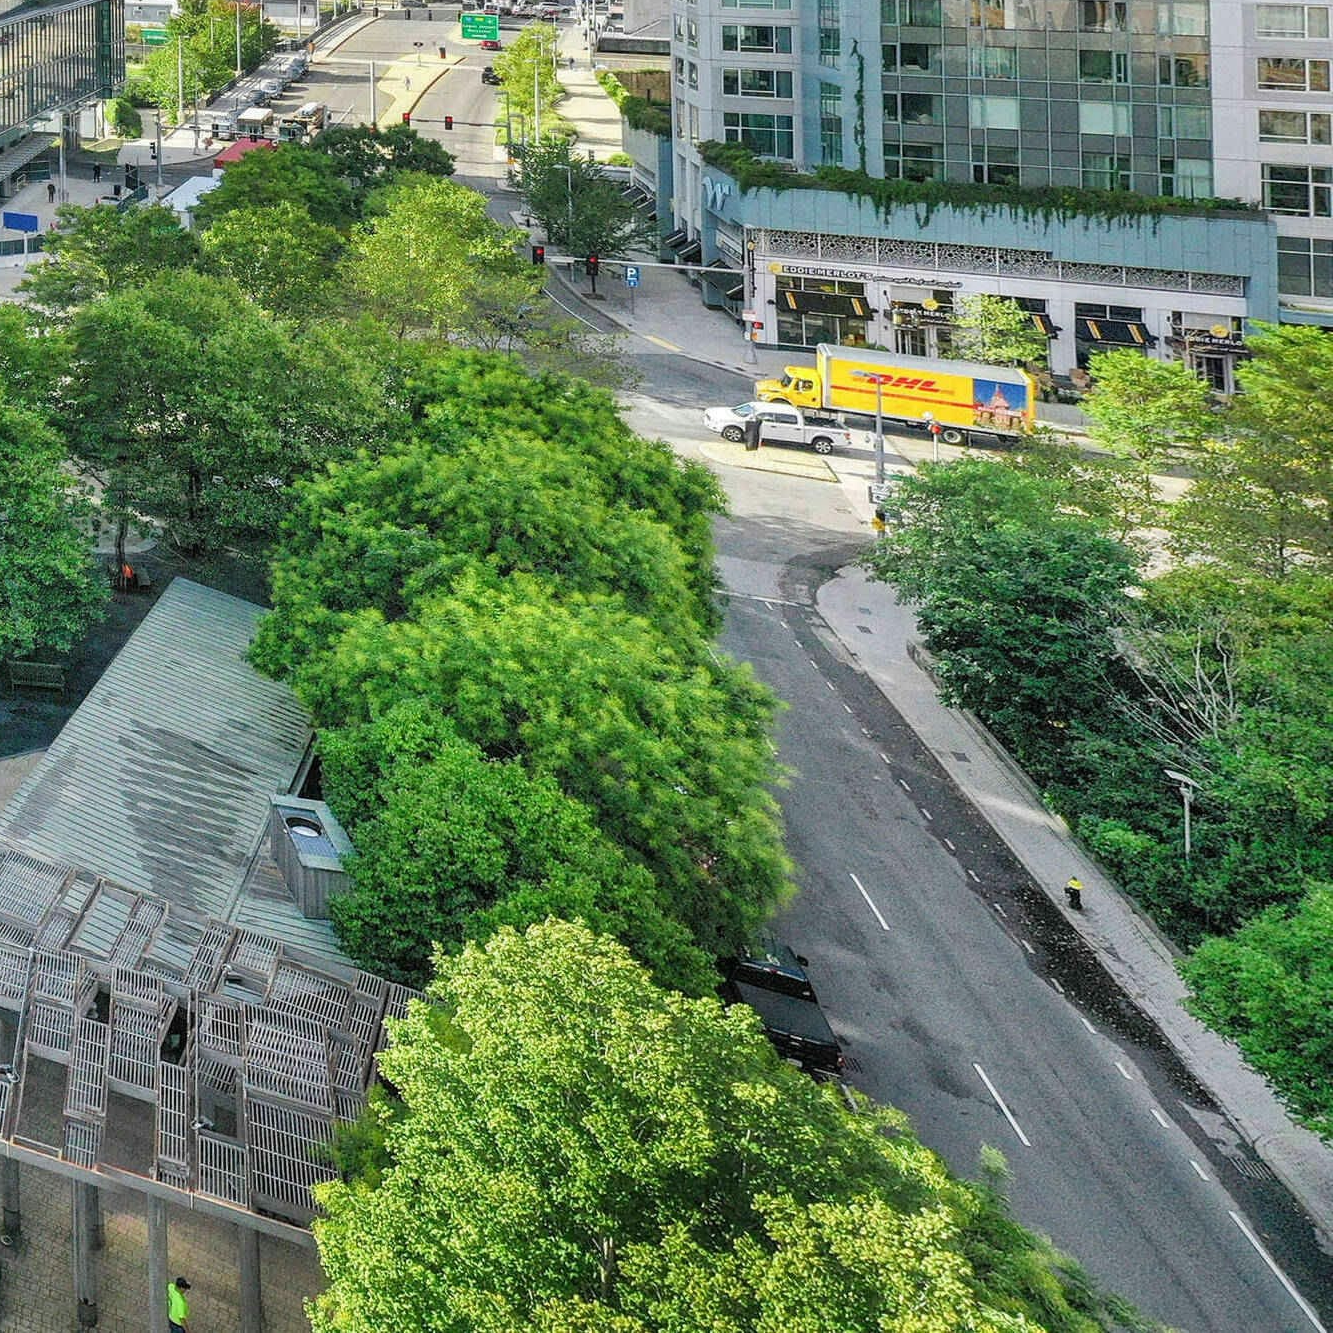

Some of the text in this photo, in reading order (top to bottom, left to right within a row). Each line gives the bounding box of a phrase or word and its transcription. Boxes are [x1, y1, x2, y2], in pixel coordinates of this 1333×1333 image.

[627, 267, 637, 278] P
[783, 266, 815, 275] EDDIE
[867, 372, 938, 393] DHL
